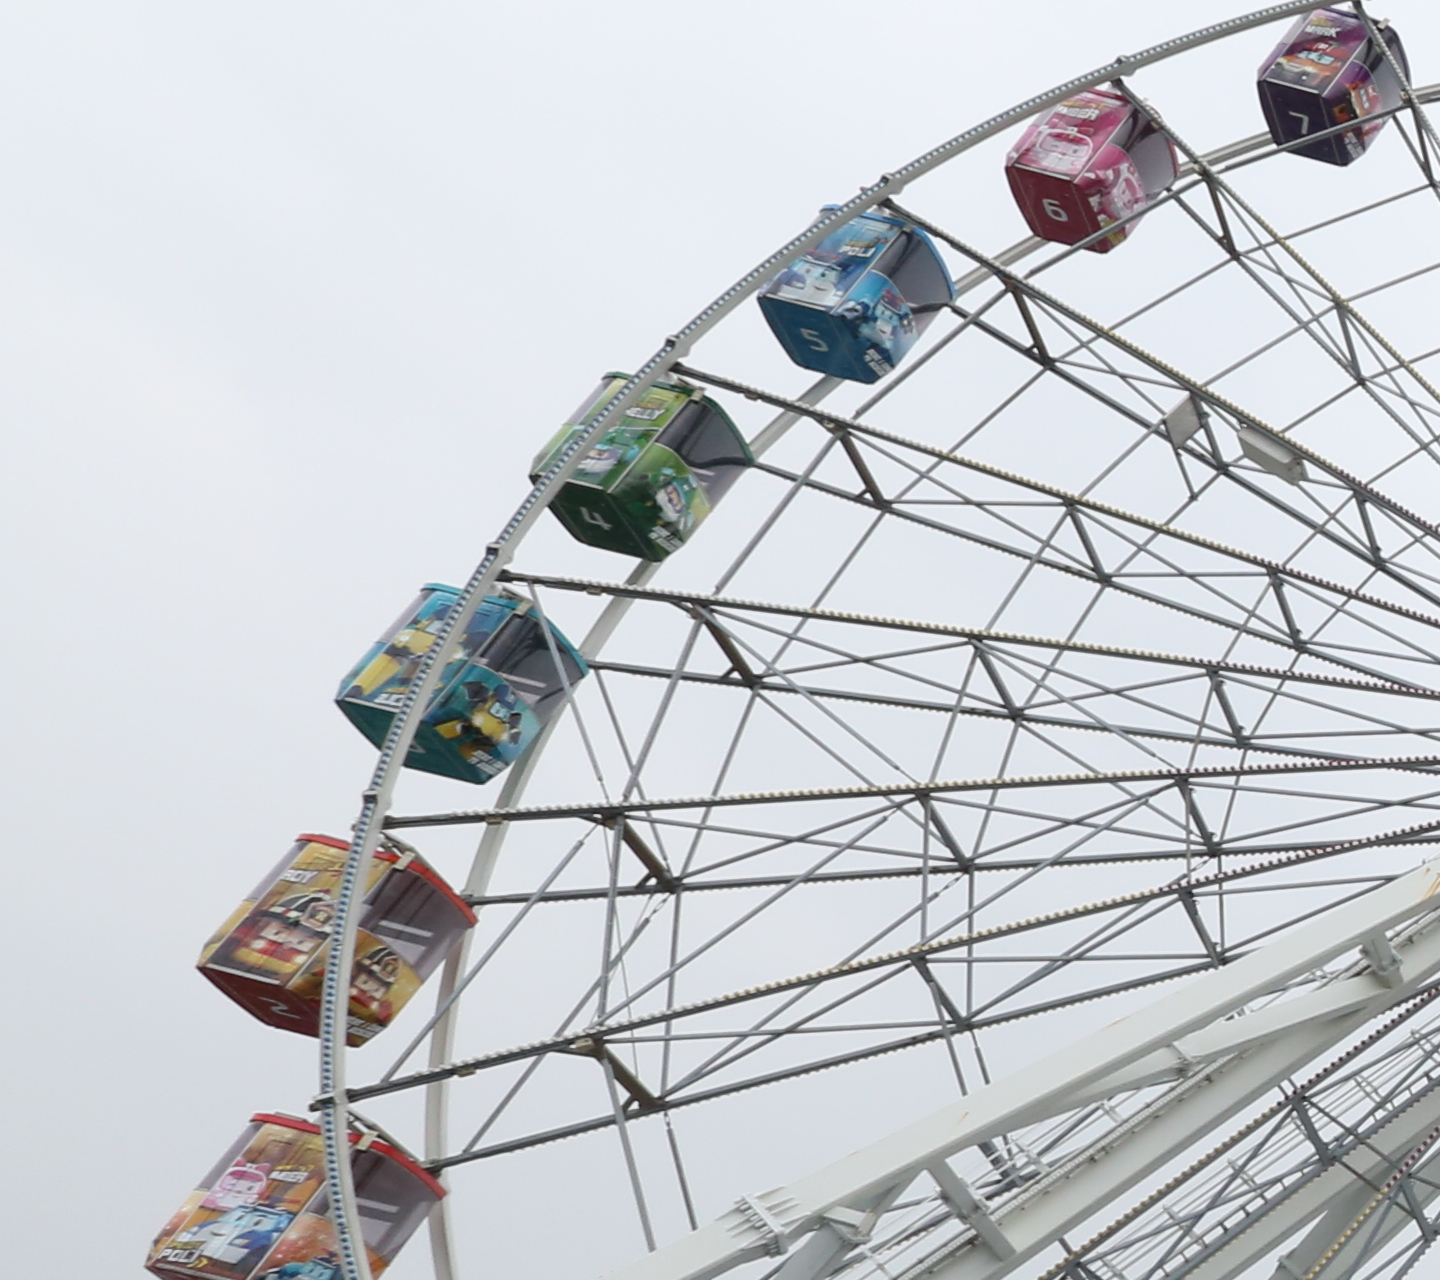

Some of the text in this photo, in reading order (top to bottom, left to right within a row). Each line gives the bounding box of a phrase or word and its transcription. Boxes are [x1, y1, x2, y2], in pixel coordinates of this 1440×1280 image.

[1288, 110, 1309, 135] 7
[1042, 198, 1068, 222] 6
[800, 328, 829, 352] 5
